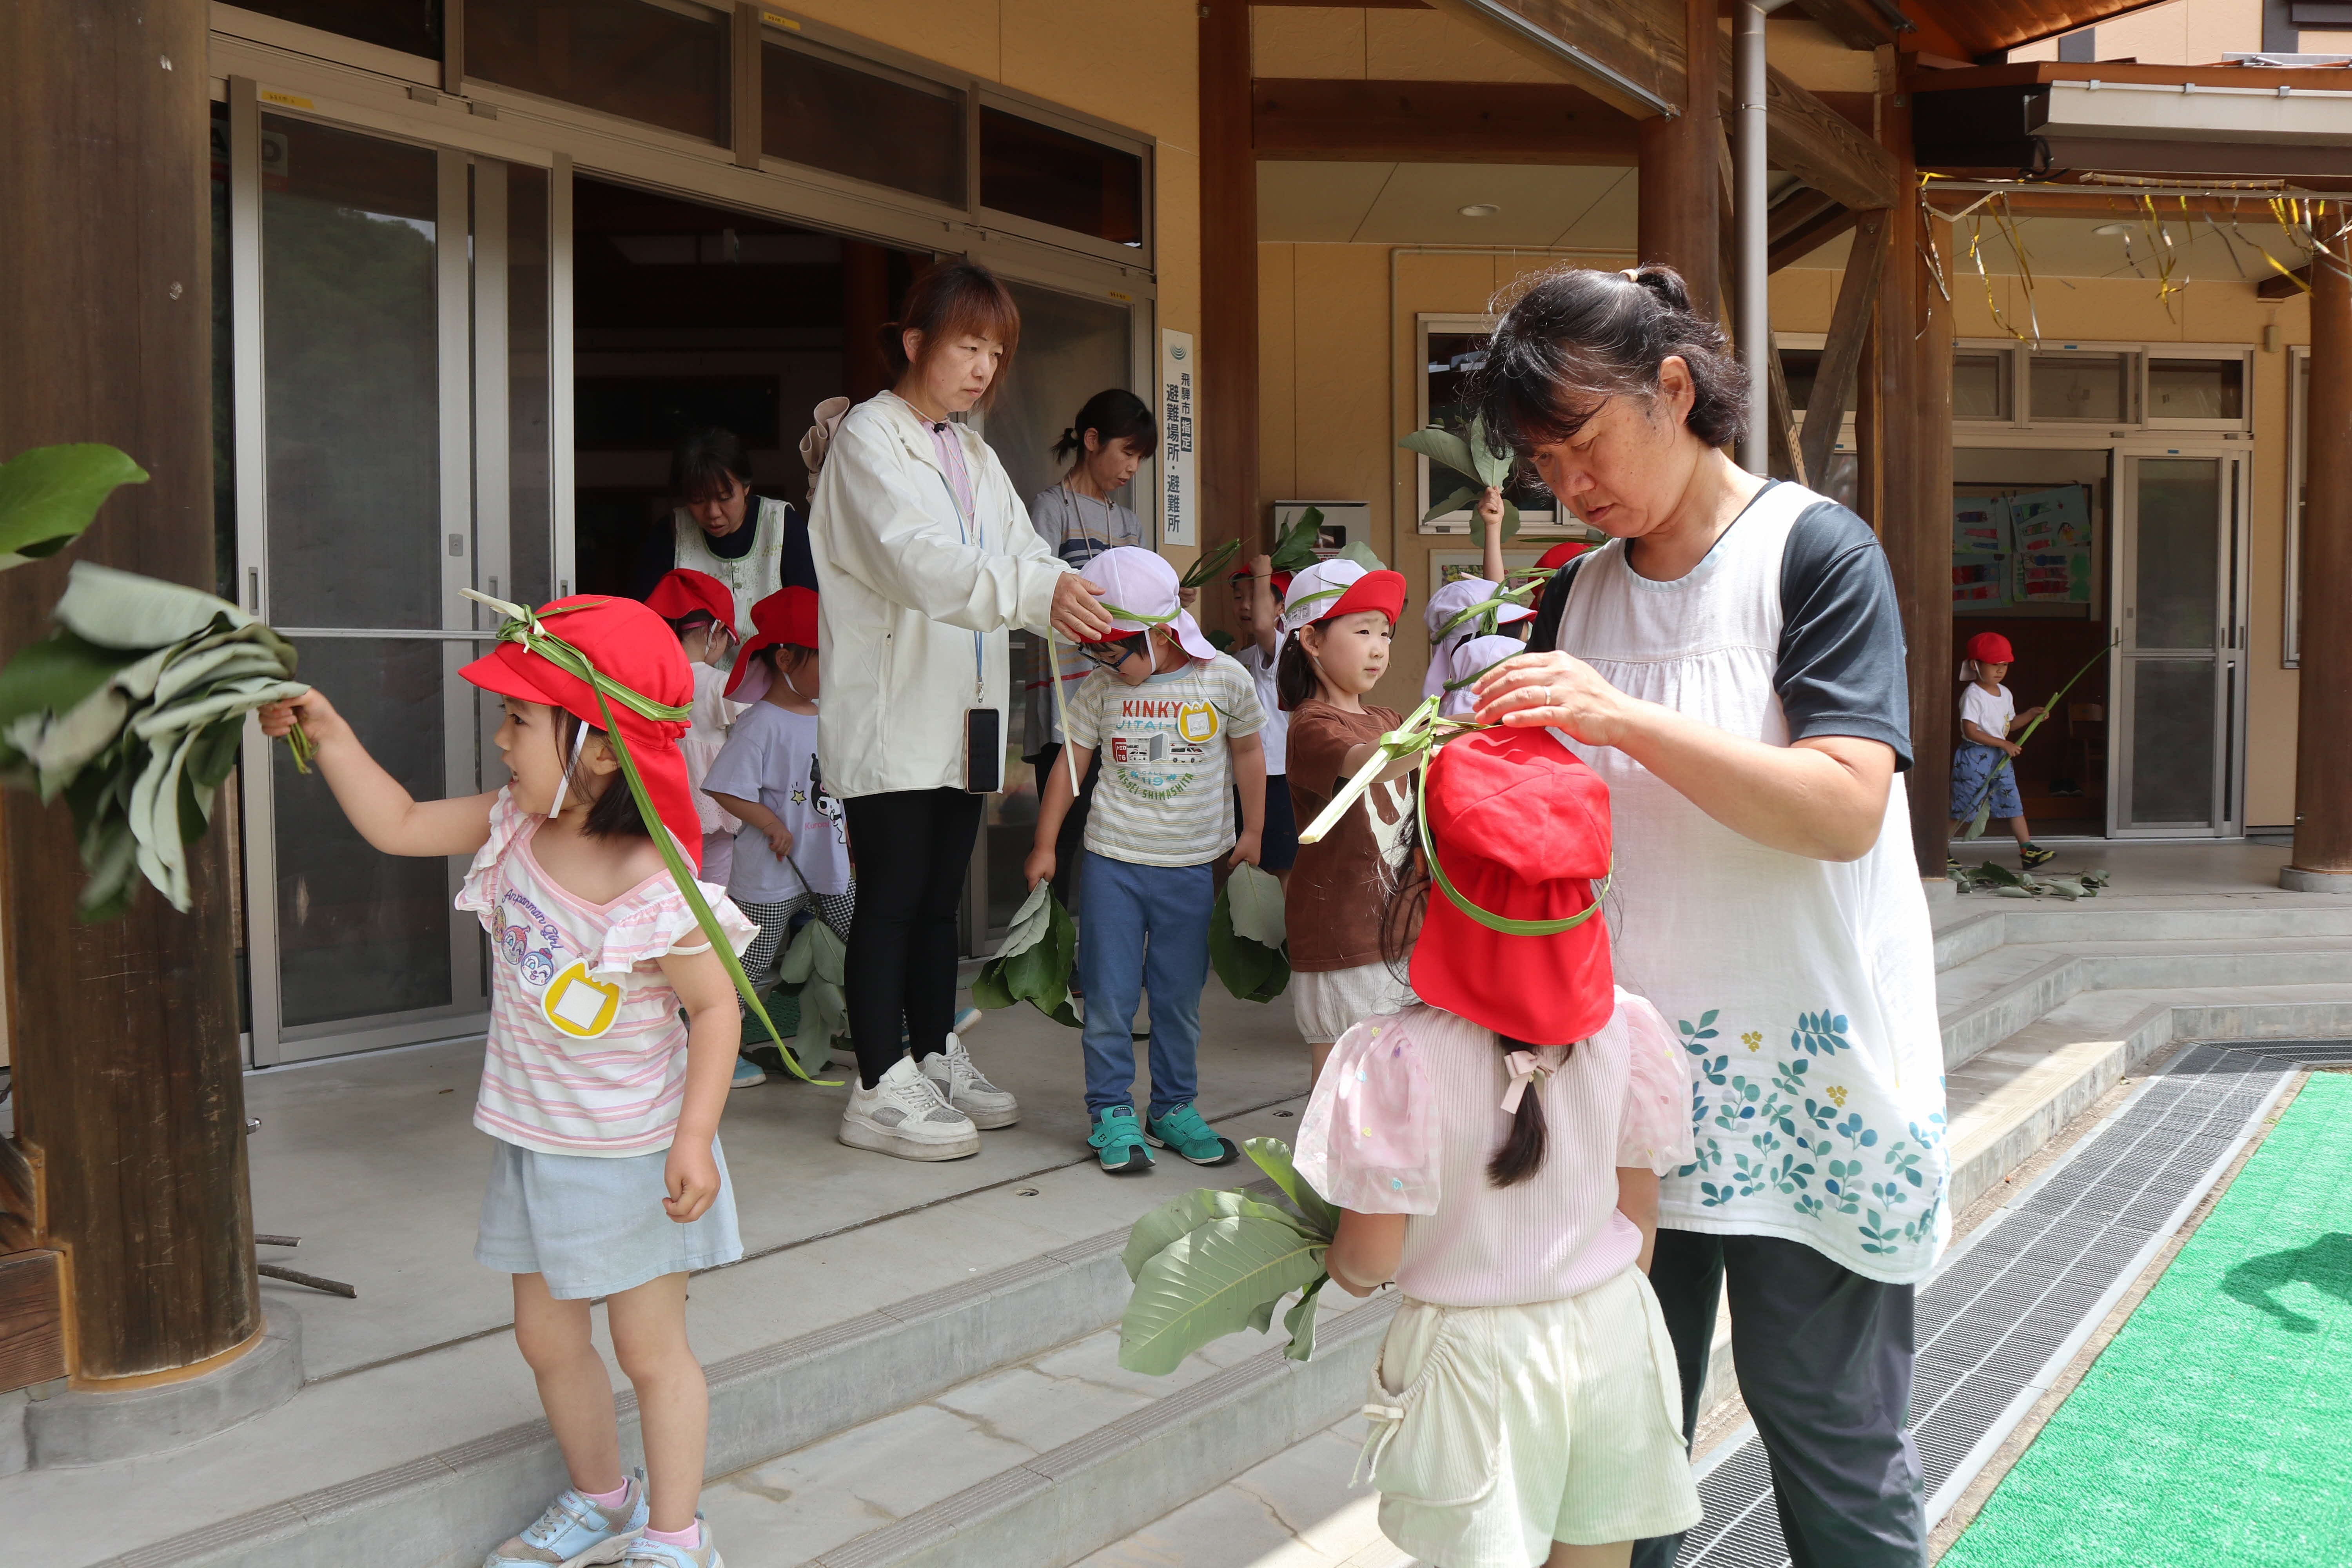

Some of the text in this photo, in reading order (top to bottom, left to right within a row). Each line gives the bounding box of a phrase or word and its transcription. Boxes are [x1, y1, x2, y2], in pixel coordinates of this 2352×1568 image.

[1166, 383, 1180, 534] 避難場所・避難所
[1122, 700, 1183, 718] KINKY
[1116, 720, 1178, 730] JITAI-
[1142, 777, 1164, 786] 119
[1142, 772, 1194, 800] SHIMASHITA
[804, 820, 830, 830] Kuromi
[502, 889, 564, 950] Anpanman Girl
[1098, 1133, 1107, 1142] E5
